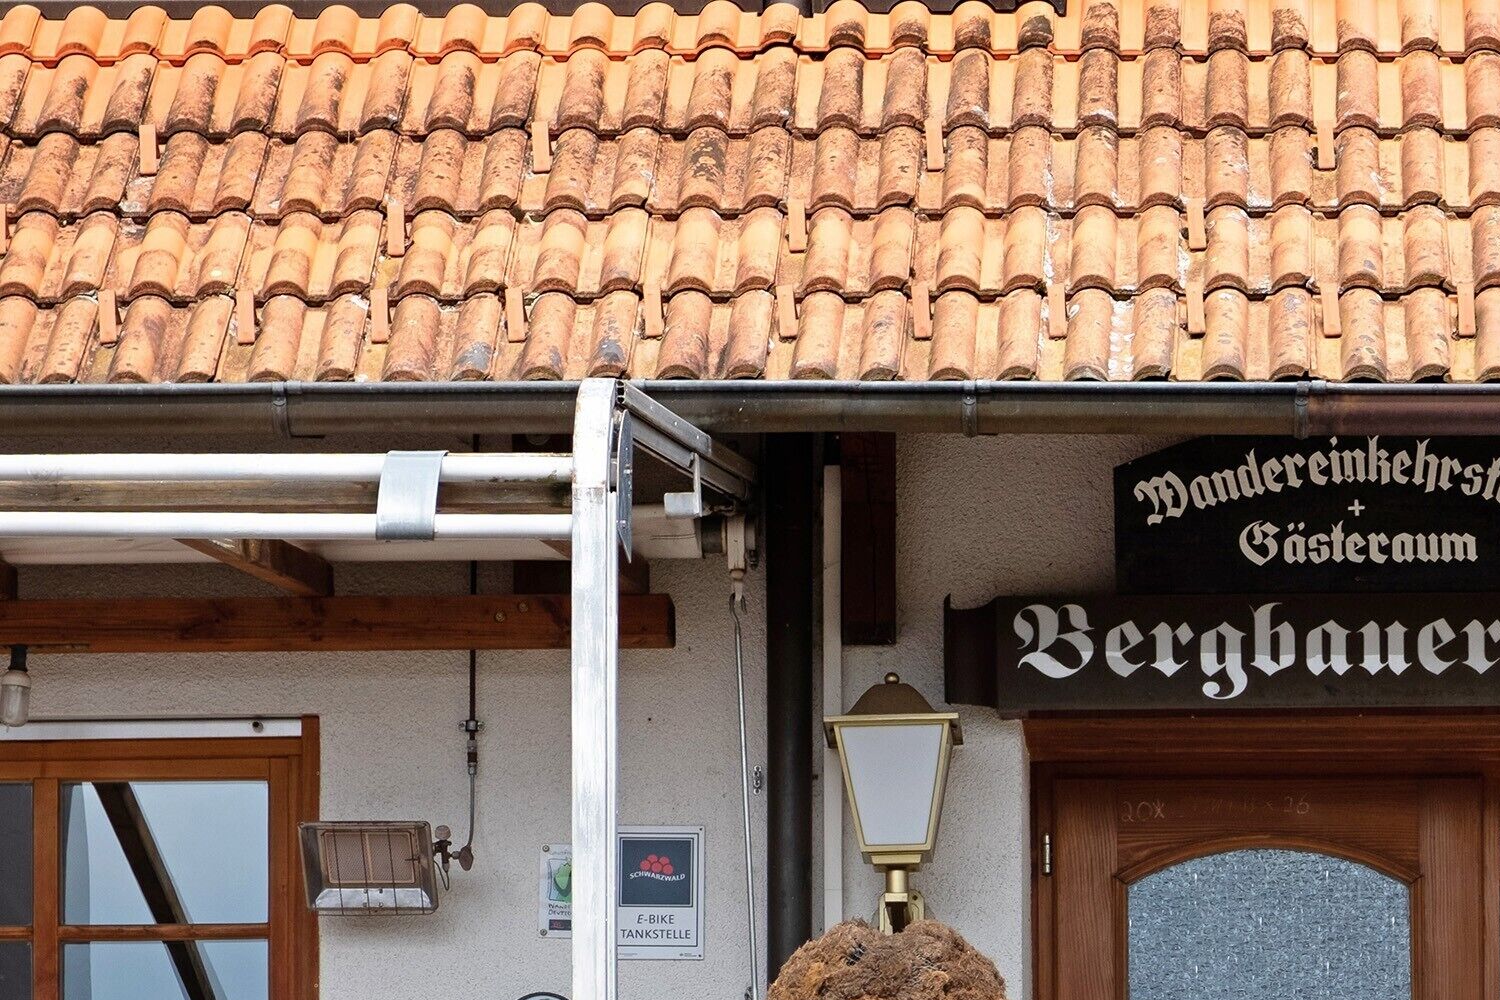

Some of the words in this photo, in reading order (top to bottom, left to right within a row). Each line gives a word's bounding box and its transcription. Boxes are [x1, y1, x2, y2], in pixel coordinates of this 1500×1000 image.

[1239, 520, 1479, 566] Gästeraum
[629, 870, 686, 882] SCHWARZWALD
[636, 914, 675, 925] E-BIKE
[620, 929, 691, 940] TANKSTELLE
